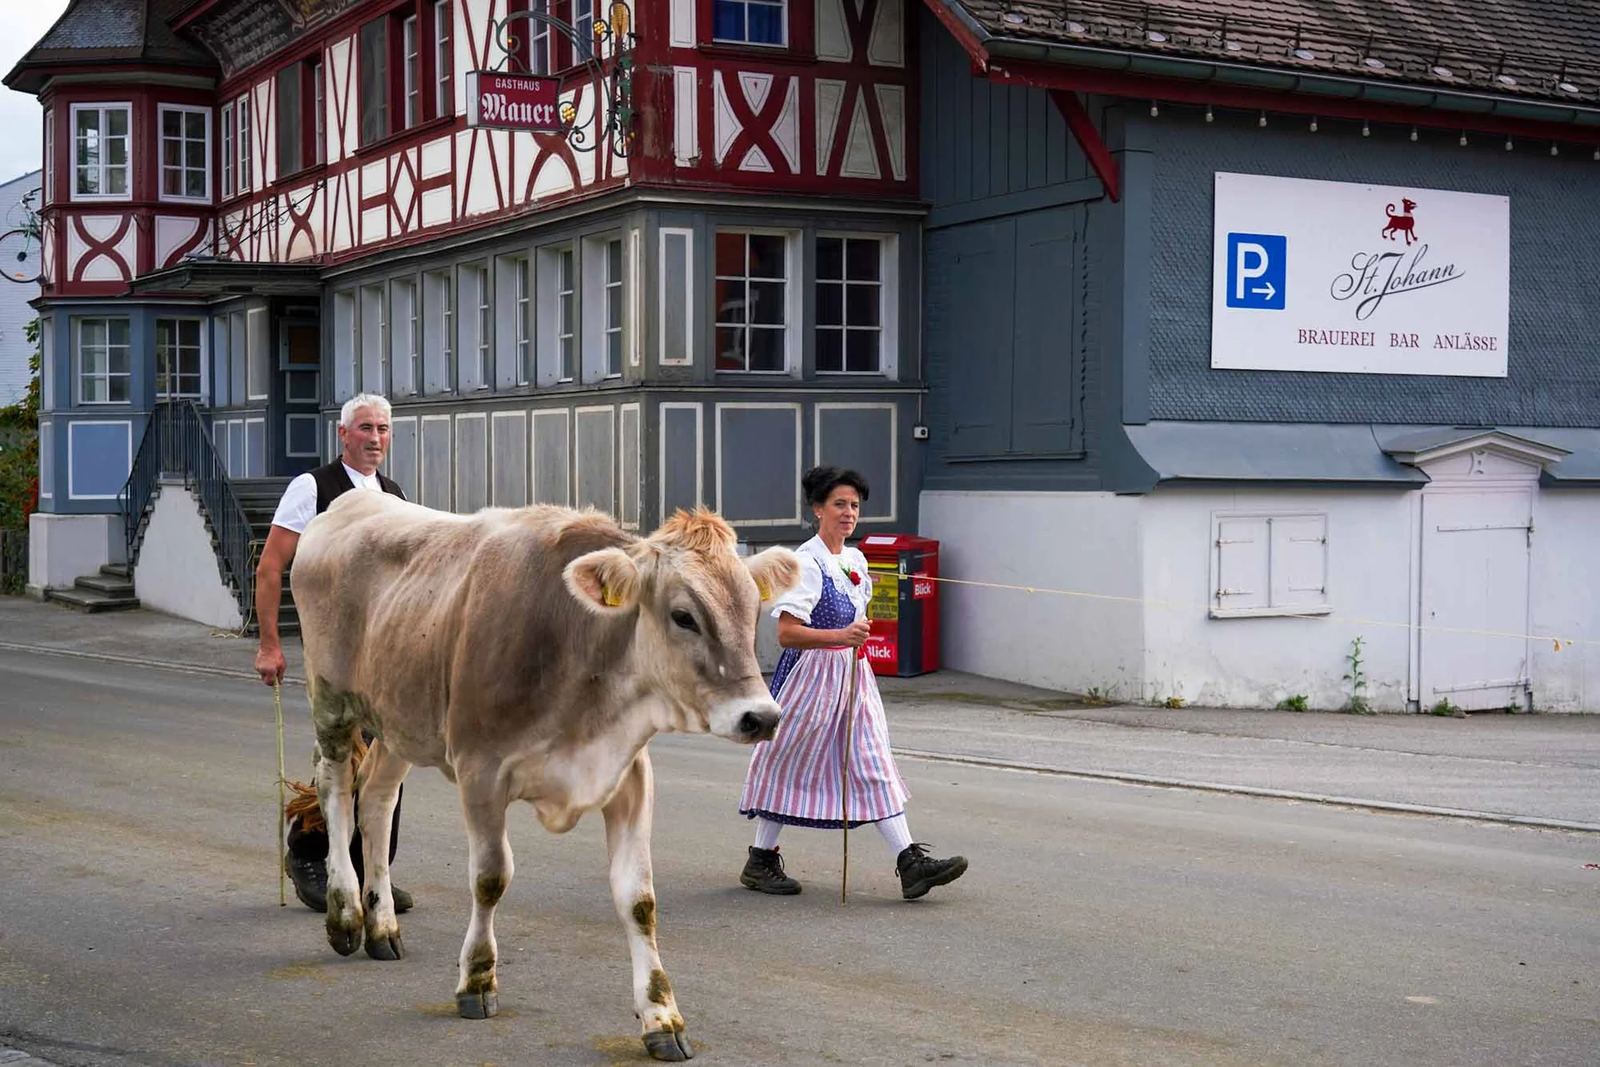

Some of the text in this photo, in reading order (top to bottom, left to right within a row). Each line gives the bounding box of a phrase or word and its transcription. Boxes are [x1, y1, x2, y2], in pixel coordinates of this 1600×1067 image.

[495, 78, 541, 91] GASTHAUS
[481, 92, 554, 124] Mauer
[1236, 242, 1269, 299] P
[1298, 328, 1498, 351] BRAUEREI BAR ANLÄSSE
[914, 582, 931, 596] Blick
